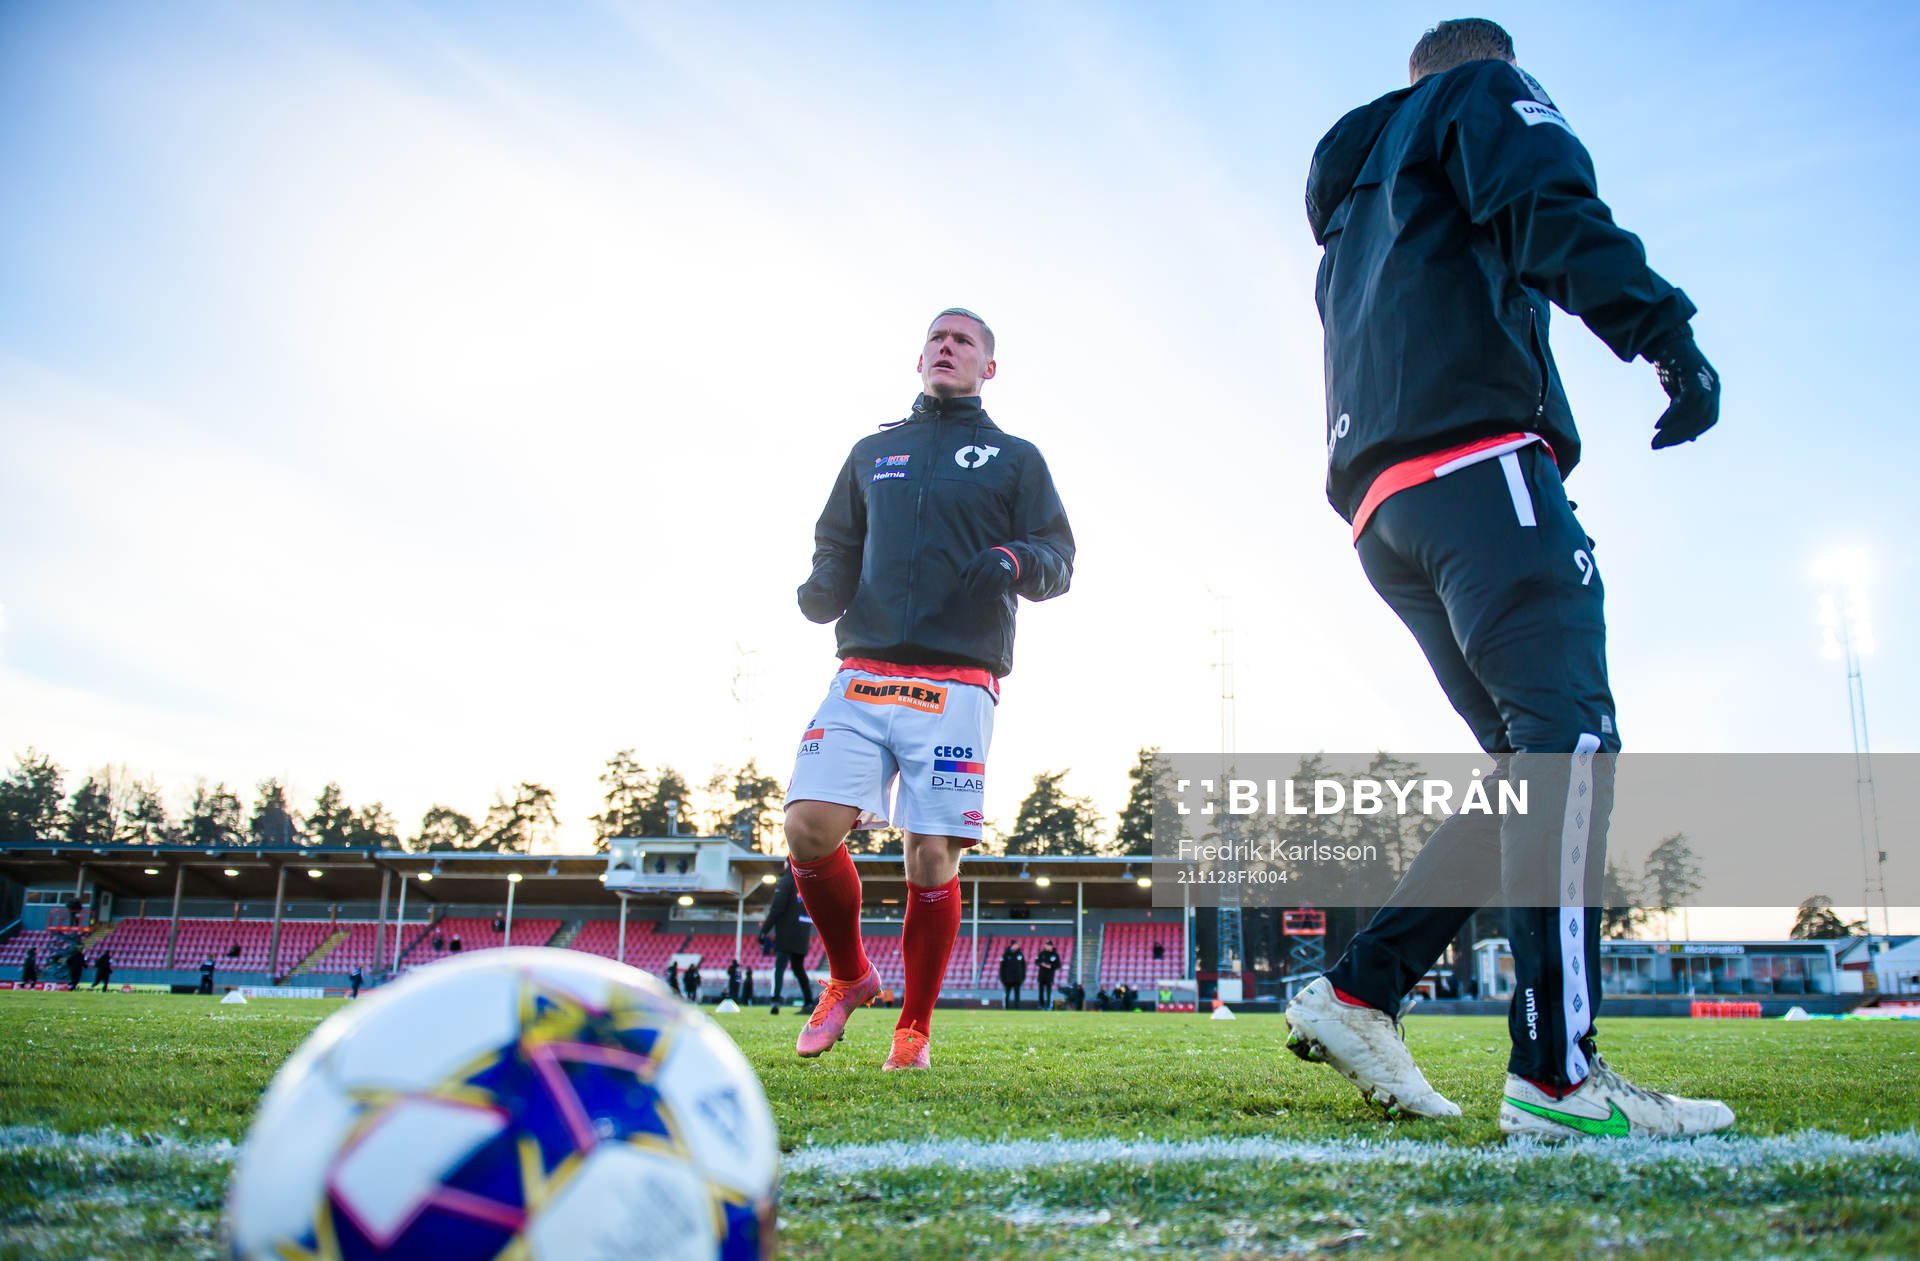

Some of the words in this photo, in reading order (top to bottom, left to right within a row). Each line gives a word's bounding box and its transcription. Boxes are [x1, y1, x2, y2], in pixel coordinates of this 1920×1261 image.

[854, 684, 941, 704] UNIFLEX
[933, 745, 973, 759] CEOS
[931, 776, 984, 790] D-LAB
[1525, 988, 1538, 1040] umbro
